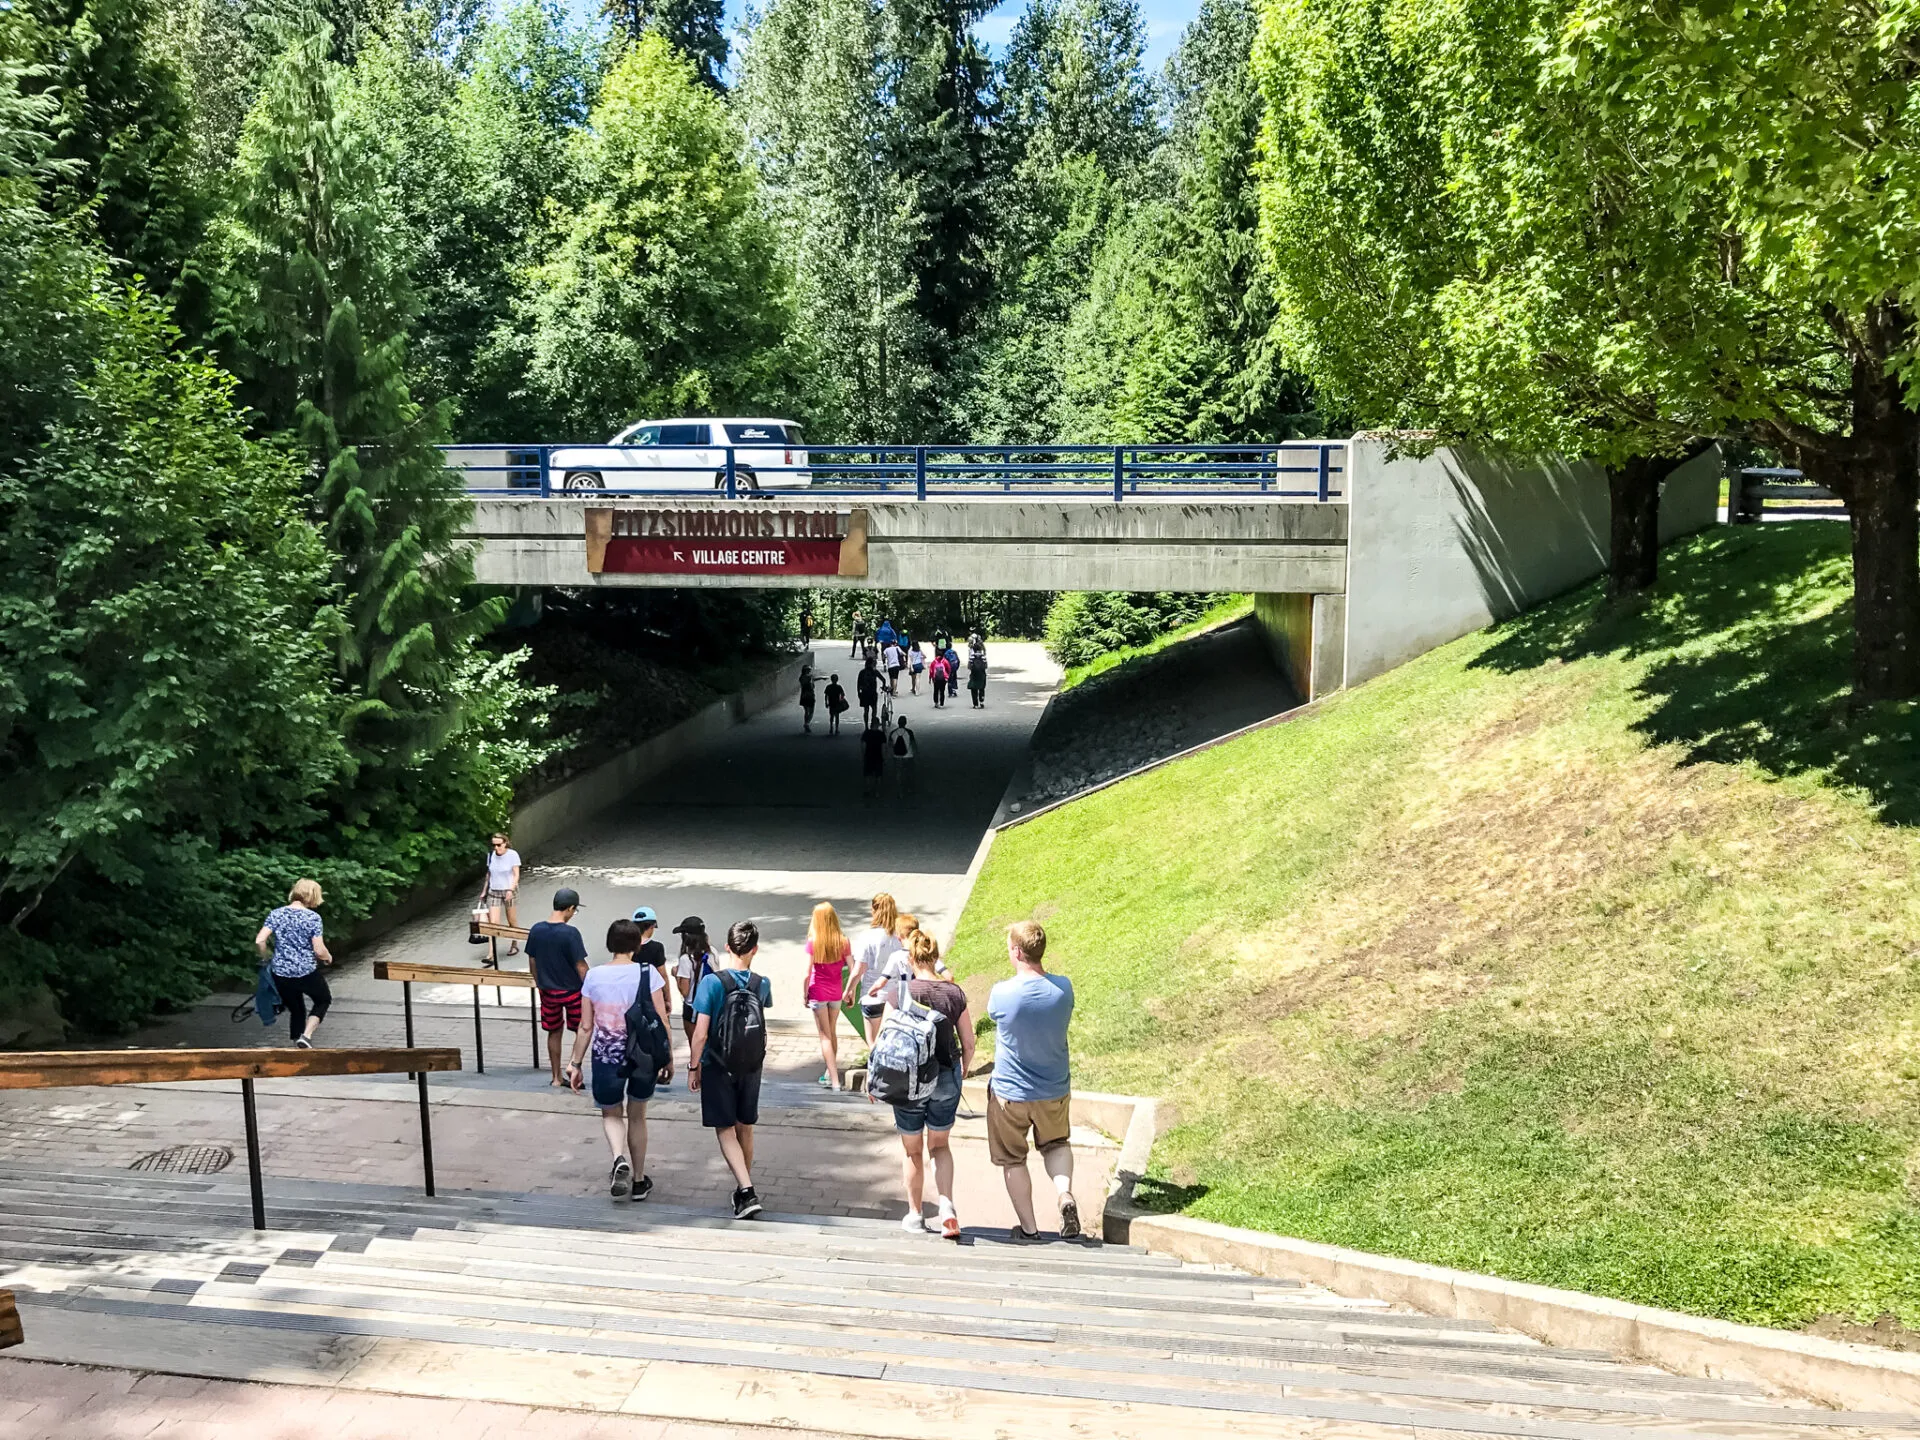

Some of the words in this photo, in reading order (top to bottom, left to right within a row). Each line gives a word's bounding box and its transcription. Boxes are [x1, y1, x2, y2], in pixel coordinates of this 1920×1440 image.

[612, 509, 775, 538] FITZSIMMONS
[779, 510, 842, 539] TRAIL
[692, 549, 739, 566] VILLAGE
[741, 550, 786, 566] CENTRE
